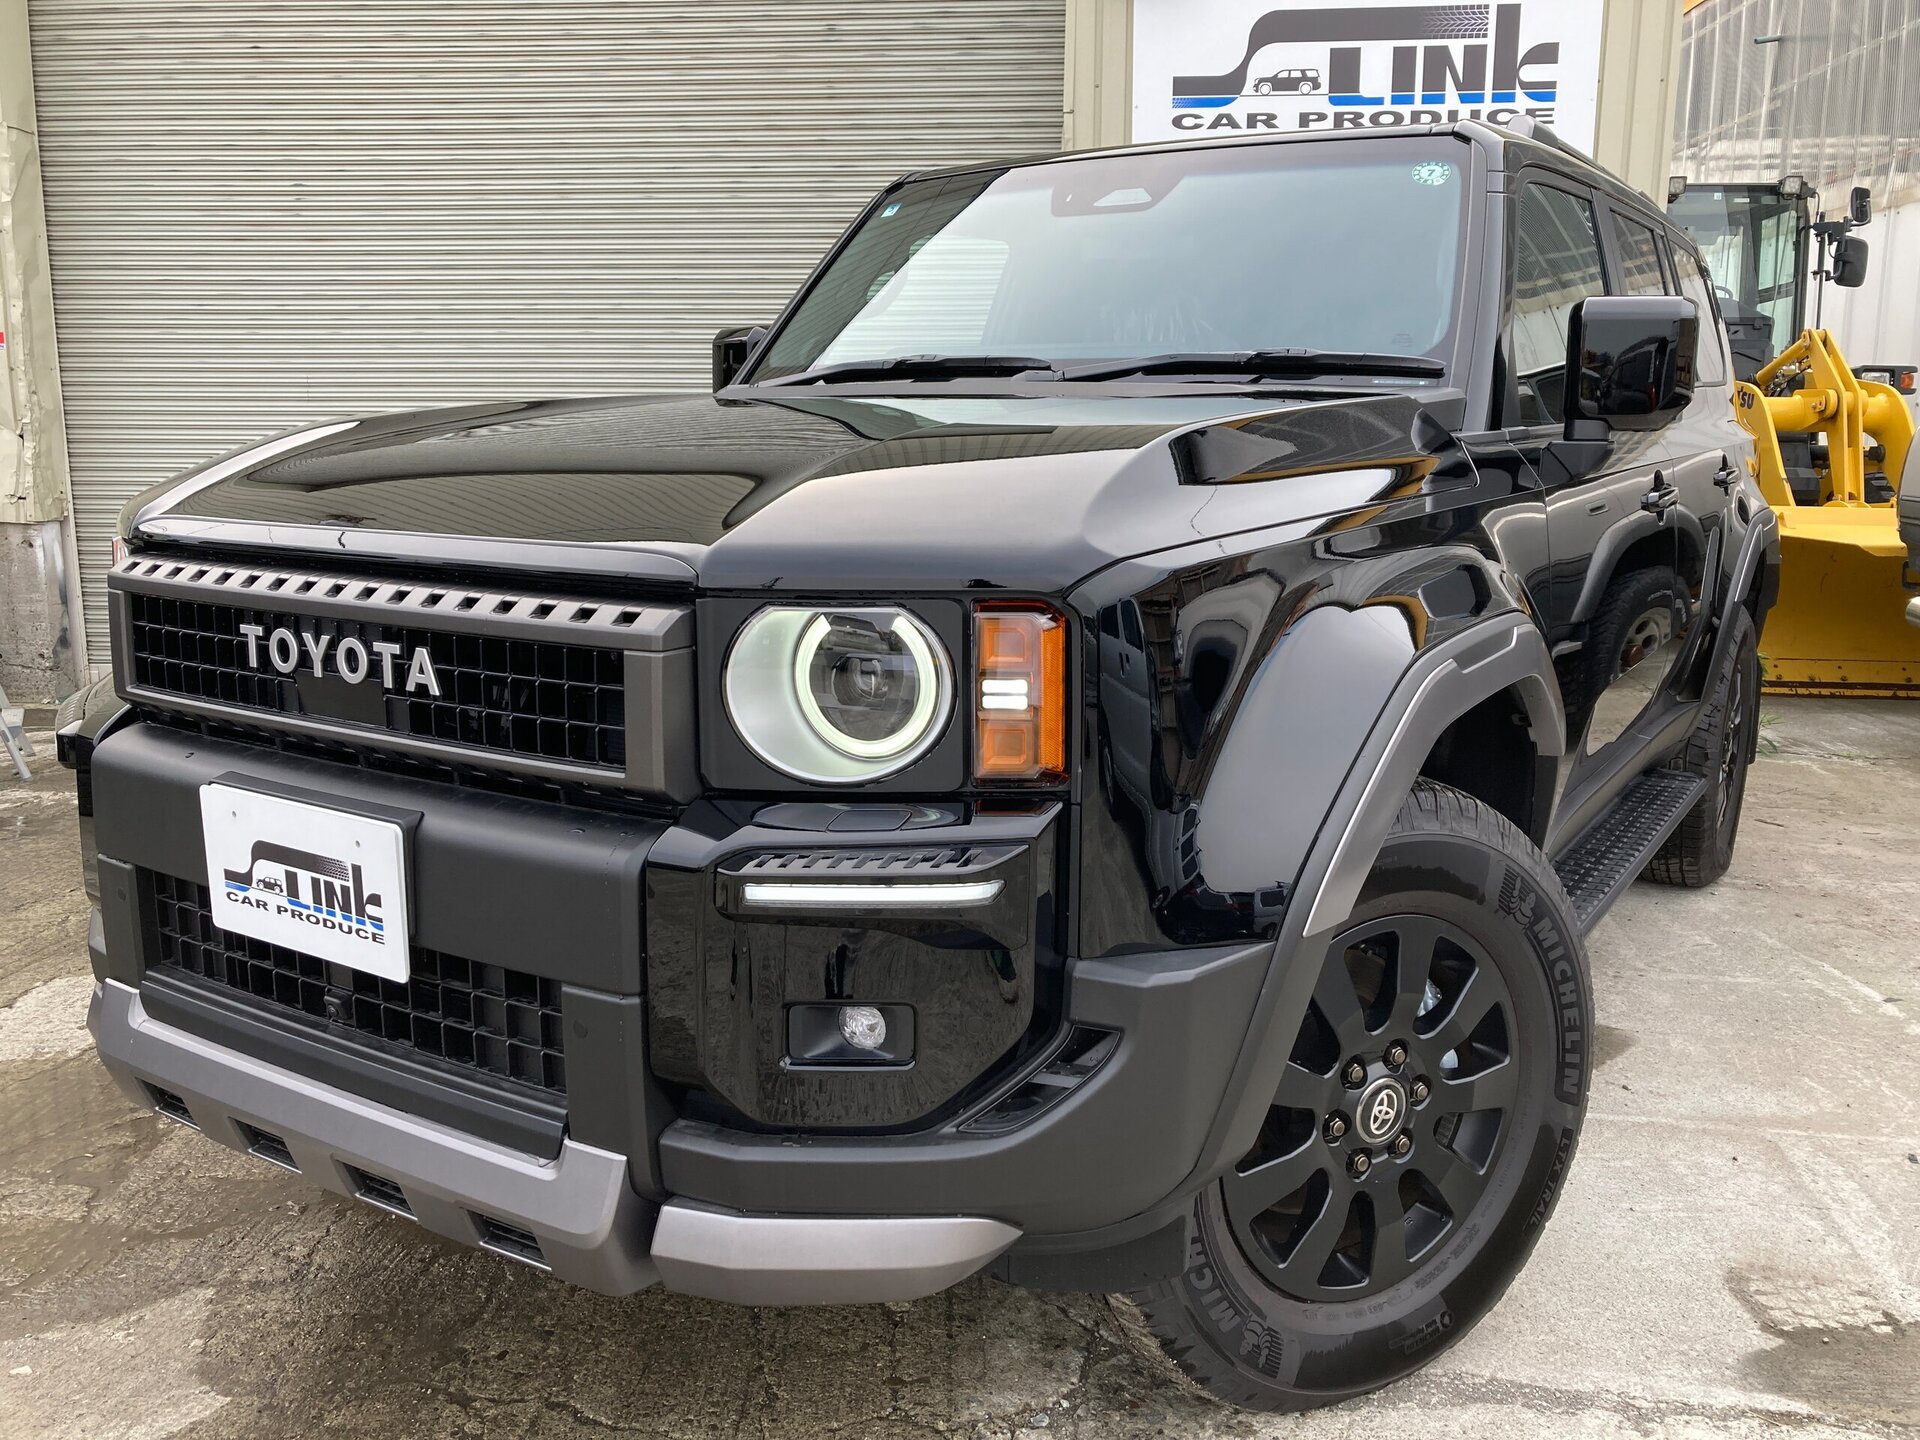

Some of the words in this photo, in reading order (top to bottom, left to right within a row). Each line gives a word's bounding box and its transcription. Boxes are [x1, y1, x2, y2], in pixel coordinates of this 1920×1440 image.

[1171, 111, 1279, 130] CAR
[1299, 107, 1555, 129] PRODUCE
[239, 623, 442, 697] TOYOTA
[226, 891, 269, 911] CAR
[276, 904, 386, 945] PRODUCE
[1532, 916, 1581, 1094] MICHELIN
[1551, 1137, 1571, 1180] LTX
[1528, 1180, 1555, 1227] TRAIL
